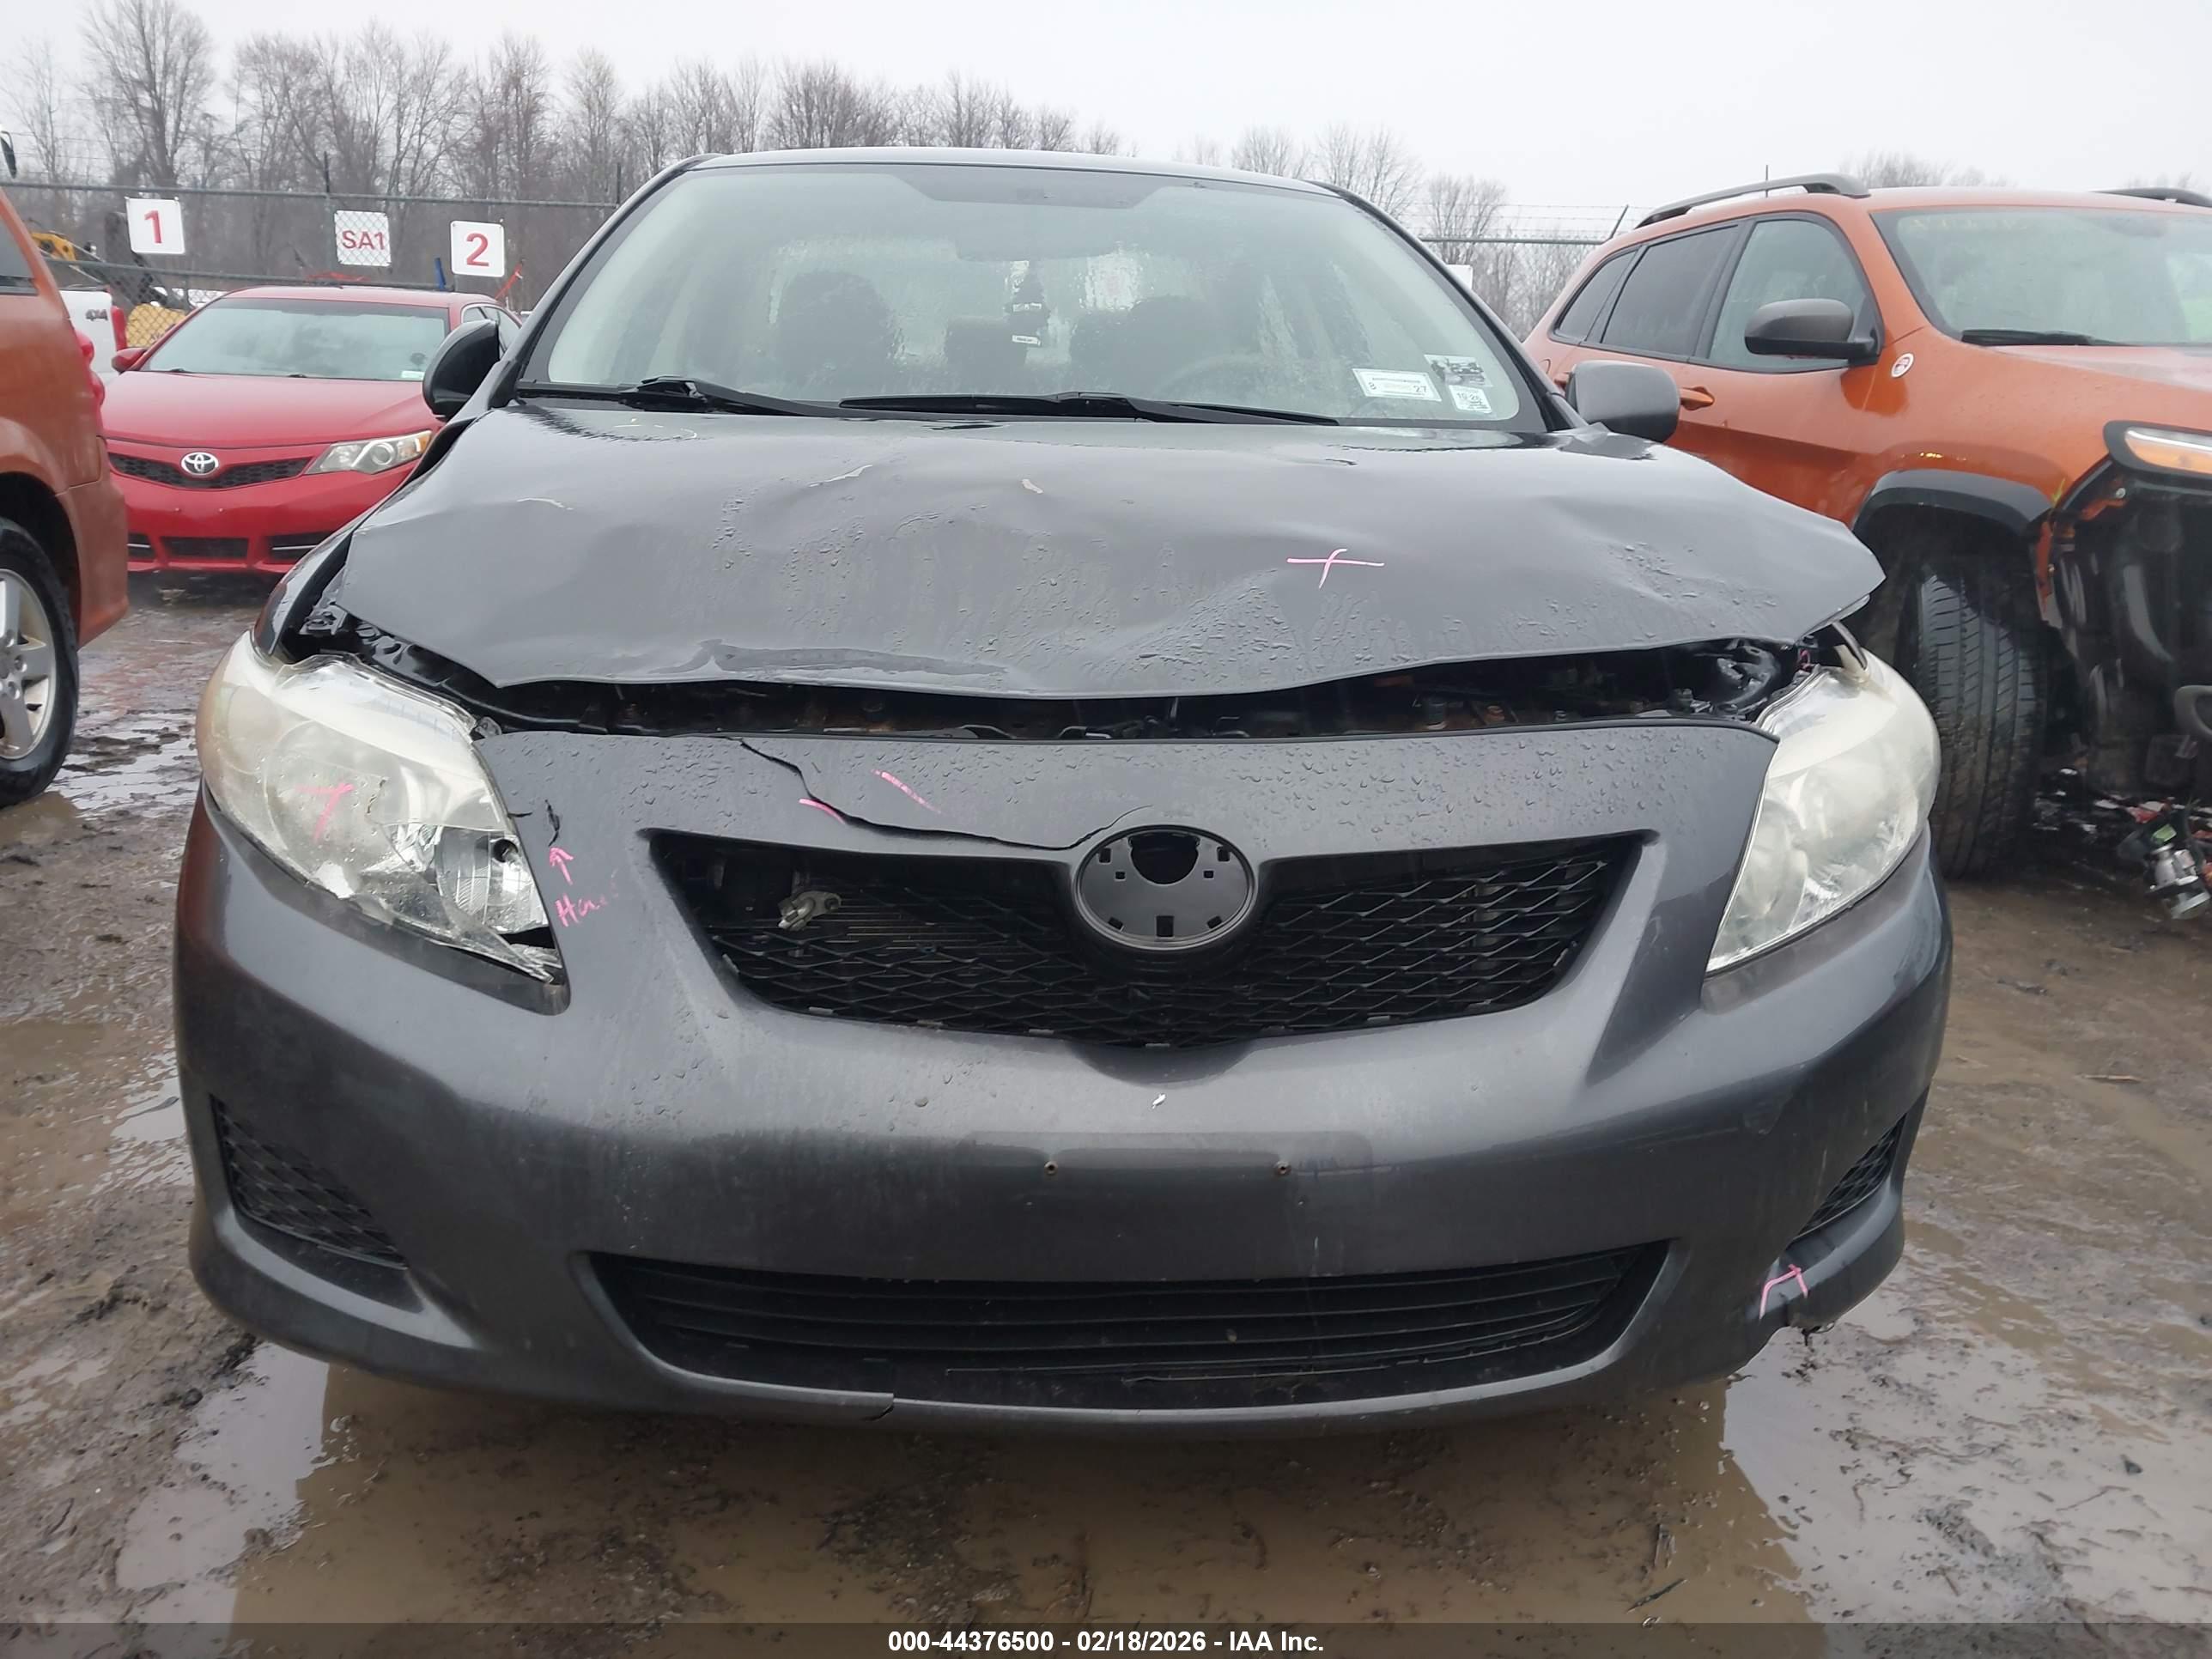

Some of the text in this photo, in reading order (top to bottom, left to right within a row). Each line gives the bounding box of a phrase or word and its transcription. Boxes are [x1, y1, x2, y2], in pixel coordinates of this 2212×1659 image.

[144, 210, 162, 245] 1
[341, 230, 386, 252] SA1
[465, 233, 490, 266] 2
